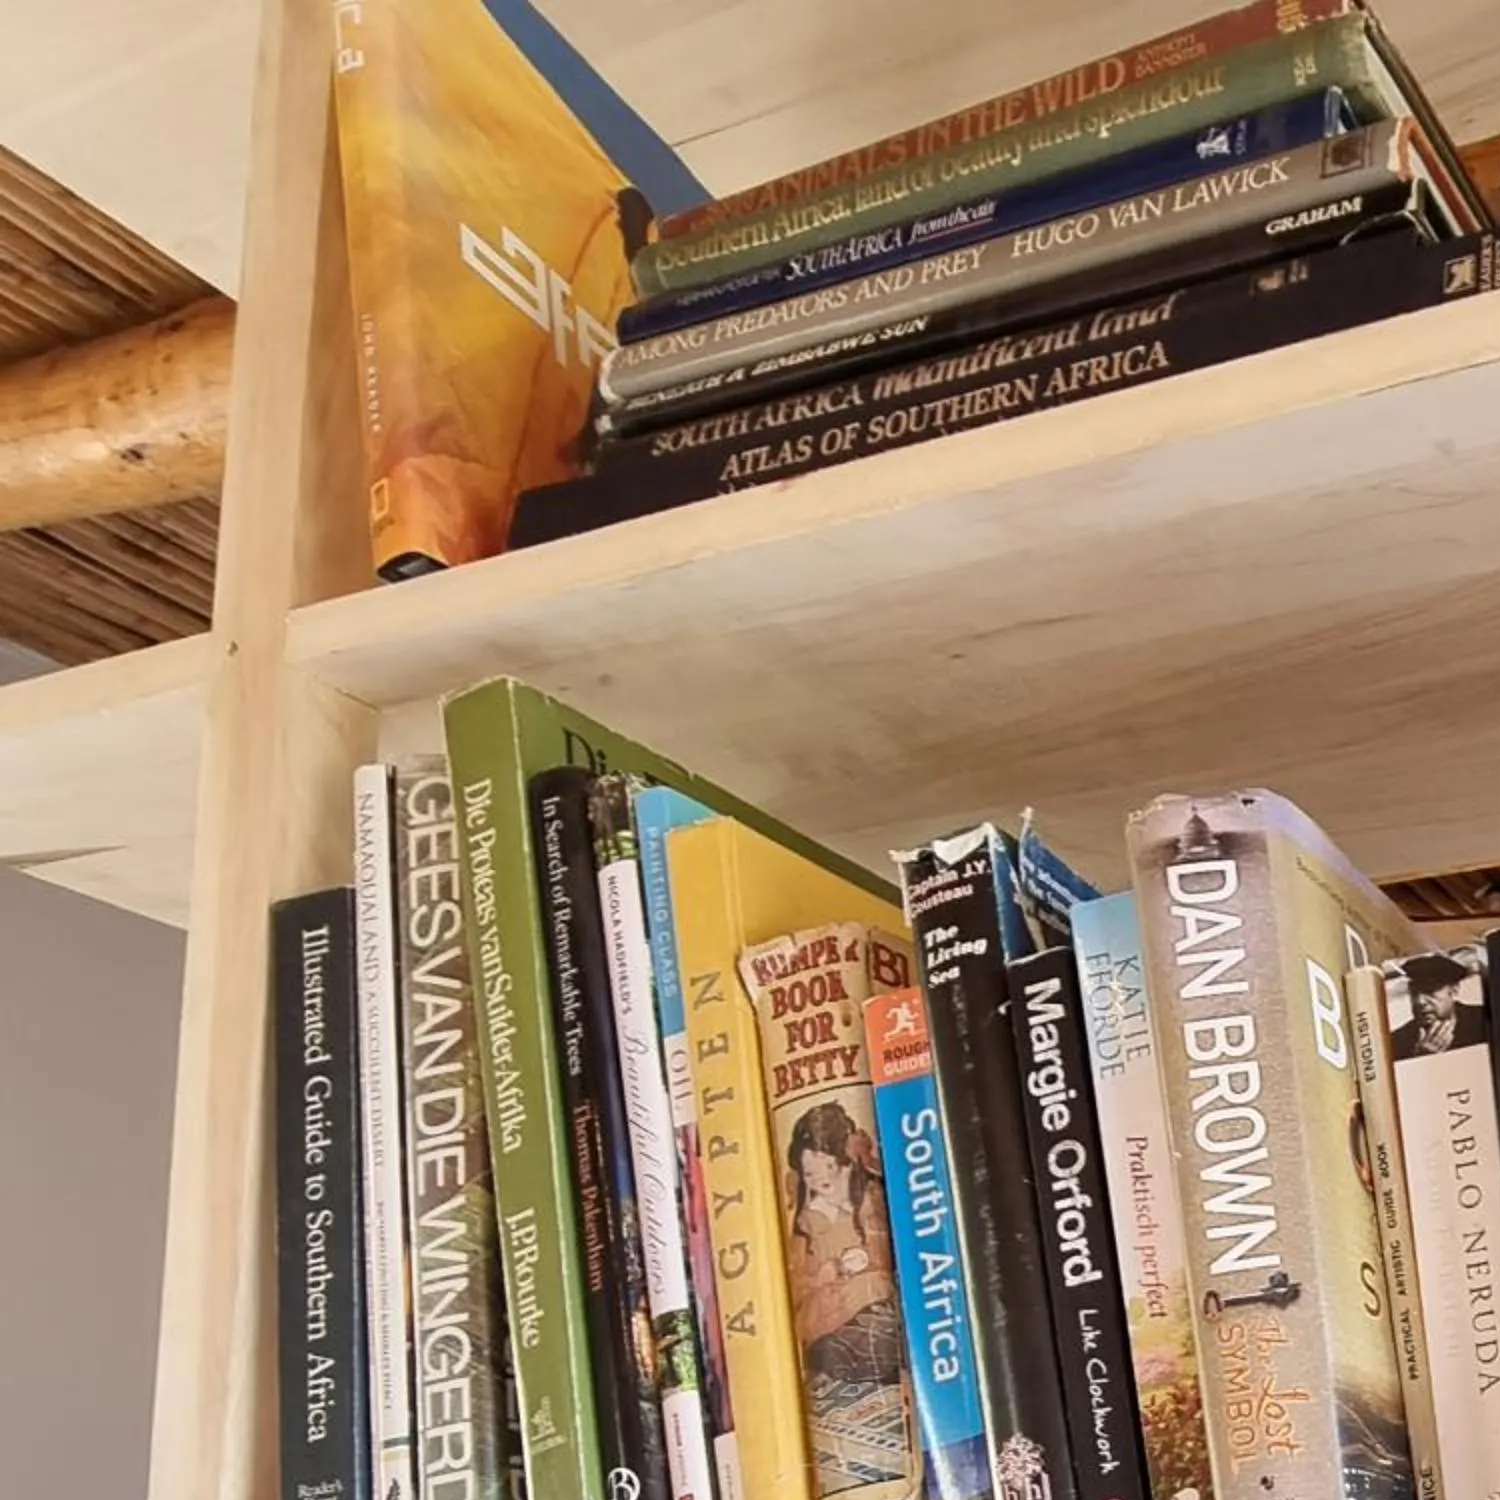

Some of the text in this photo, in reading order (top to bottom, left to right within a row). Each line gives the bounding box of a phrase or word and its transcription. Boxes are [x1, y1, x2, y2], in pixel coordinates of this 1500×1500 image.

[656, 223, 769, 271] Southern
[854, 170, 911, 213] land
[911, 164, 937, 195] of
[939, 131, 1024, 183] beauty
[1026, 105, 1081, 152] and
[1086, 65, 1227, 138] splendour
[764, 56, 1127, 205] ANIMALS IN THE WILD
[613, 328, 709, 370] AMONG
[713, 286, 849, 343] PREDATORS
[853, 268, 914, 304] AND
[920, 245, 988, 285] PREY
[1010, 212, 1099, 258] HUGO
[1108, 190, 1166, 229] VAN
[1170, 156, 1293, 213] LAWICK
[879, 197, 1363, 342] SUN GRAHAM
[649, 289, 1180, 458] SOUTH AFRICA magnificent land
[718, 339, 1172, 484] ATLAS OF SOUTHERN AFRICA
[404, 776, 463, 948] GEES
[462, 777, 493, 829] Die
[356, 792, 380, 977] NAMAQUALAND
[467, 828, 498, 928] Proteas
[606, 875, 621, 928] NICOLA
[645, 826, 679, 999] PAINTING CLASS
[910, 884, 974, 919] Cousteau
[924, 925, 959, 948] The
[410, 946, 465, 1082] VAN
[769, 971, 849, 1020] BOOK
[926, 937, 989, 969] Living
[928, 966, 961, 989] Sea
[1085, 952, 1127, 1080] FFORDE
[1113, 954, 1151, 1063] KATIE
[483, 973, 529, 1155] Suider-Afrika
[541, 795, 605, 1293] In Search of Remarkable Trees Thomas Pakenham
[622, 1025, 660, 1166] Beautiful
[669, 1048, 695, 1102] OIL
[772, 1044, 861, 1099] BETTY
[783, 1010, 839, 1055] FOR
[1023, 976, 1078, 1133] Margie
[1165, 858, 1282, 1276] DAN BROWN
[1355, 1010, 1377, 1083] ENGLISH
[301, 924, 336, 1443] Illustrated Guide to Southern Africa
[414, 1086, 466, 1197] DIE
[690, 969, 758, 1338] ÄGYPTEN
[1446, 1088, 1484, 1211] PABLO
[640, 1172, 667, 1296] Outdoors
[900, 1106, 963, 1384] South Africa
[1046, 1139, 1103, 1288] Orford
[1125, 1135, 1169, 1319] Praktisch perfect
[1381, 1188, 1398, 1229] GUIDE
[1390, 1239, 1409, 1297] ARTISTIC
[1078, 1308, 1104, 1354] Like
[1400, 1307, 1420, 1381] PRACTICAL
[1085, 1357, 1121, 1475] Clockwork
[1216, 1323, 1257, 1466] SYMBOL
[1255, 1372, 1311, 1458] Lost
